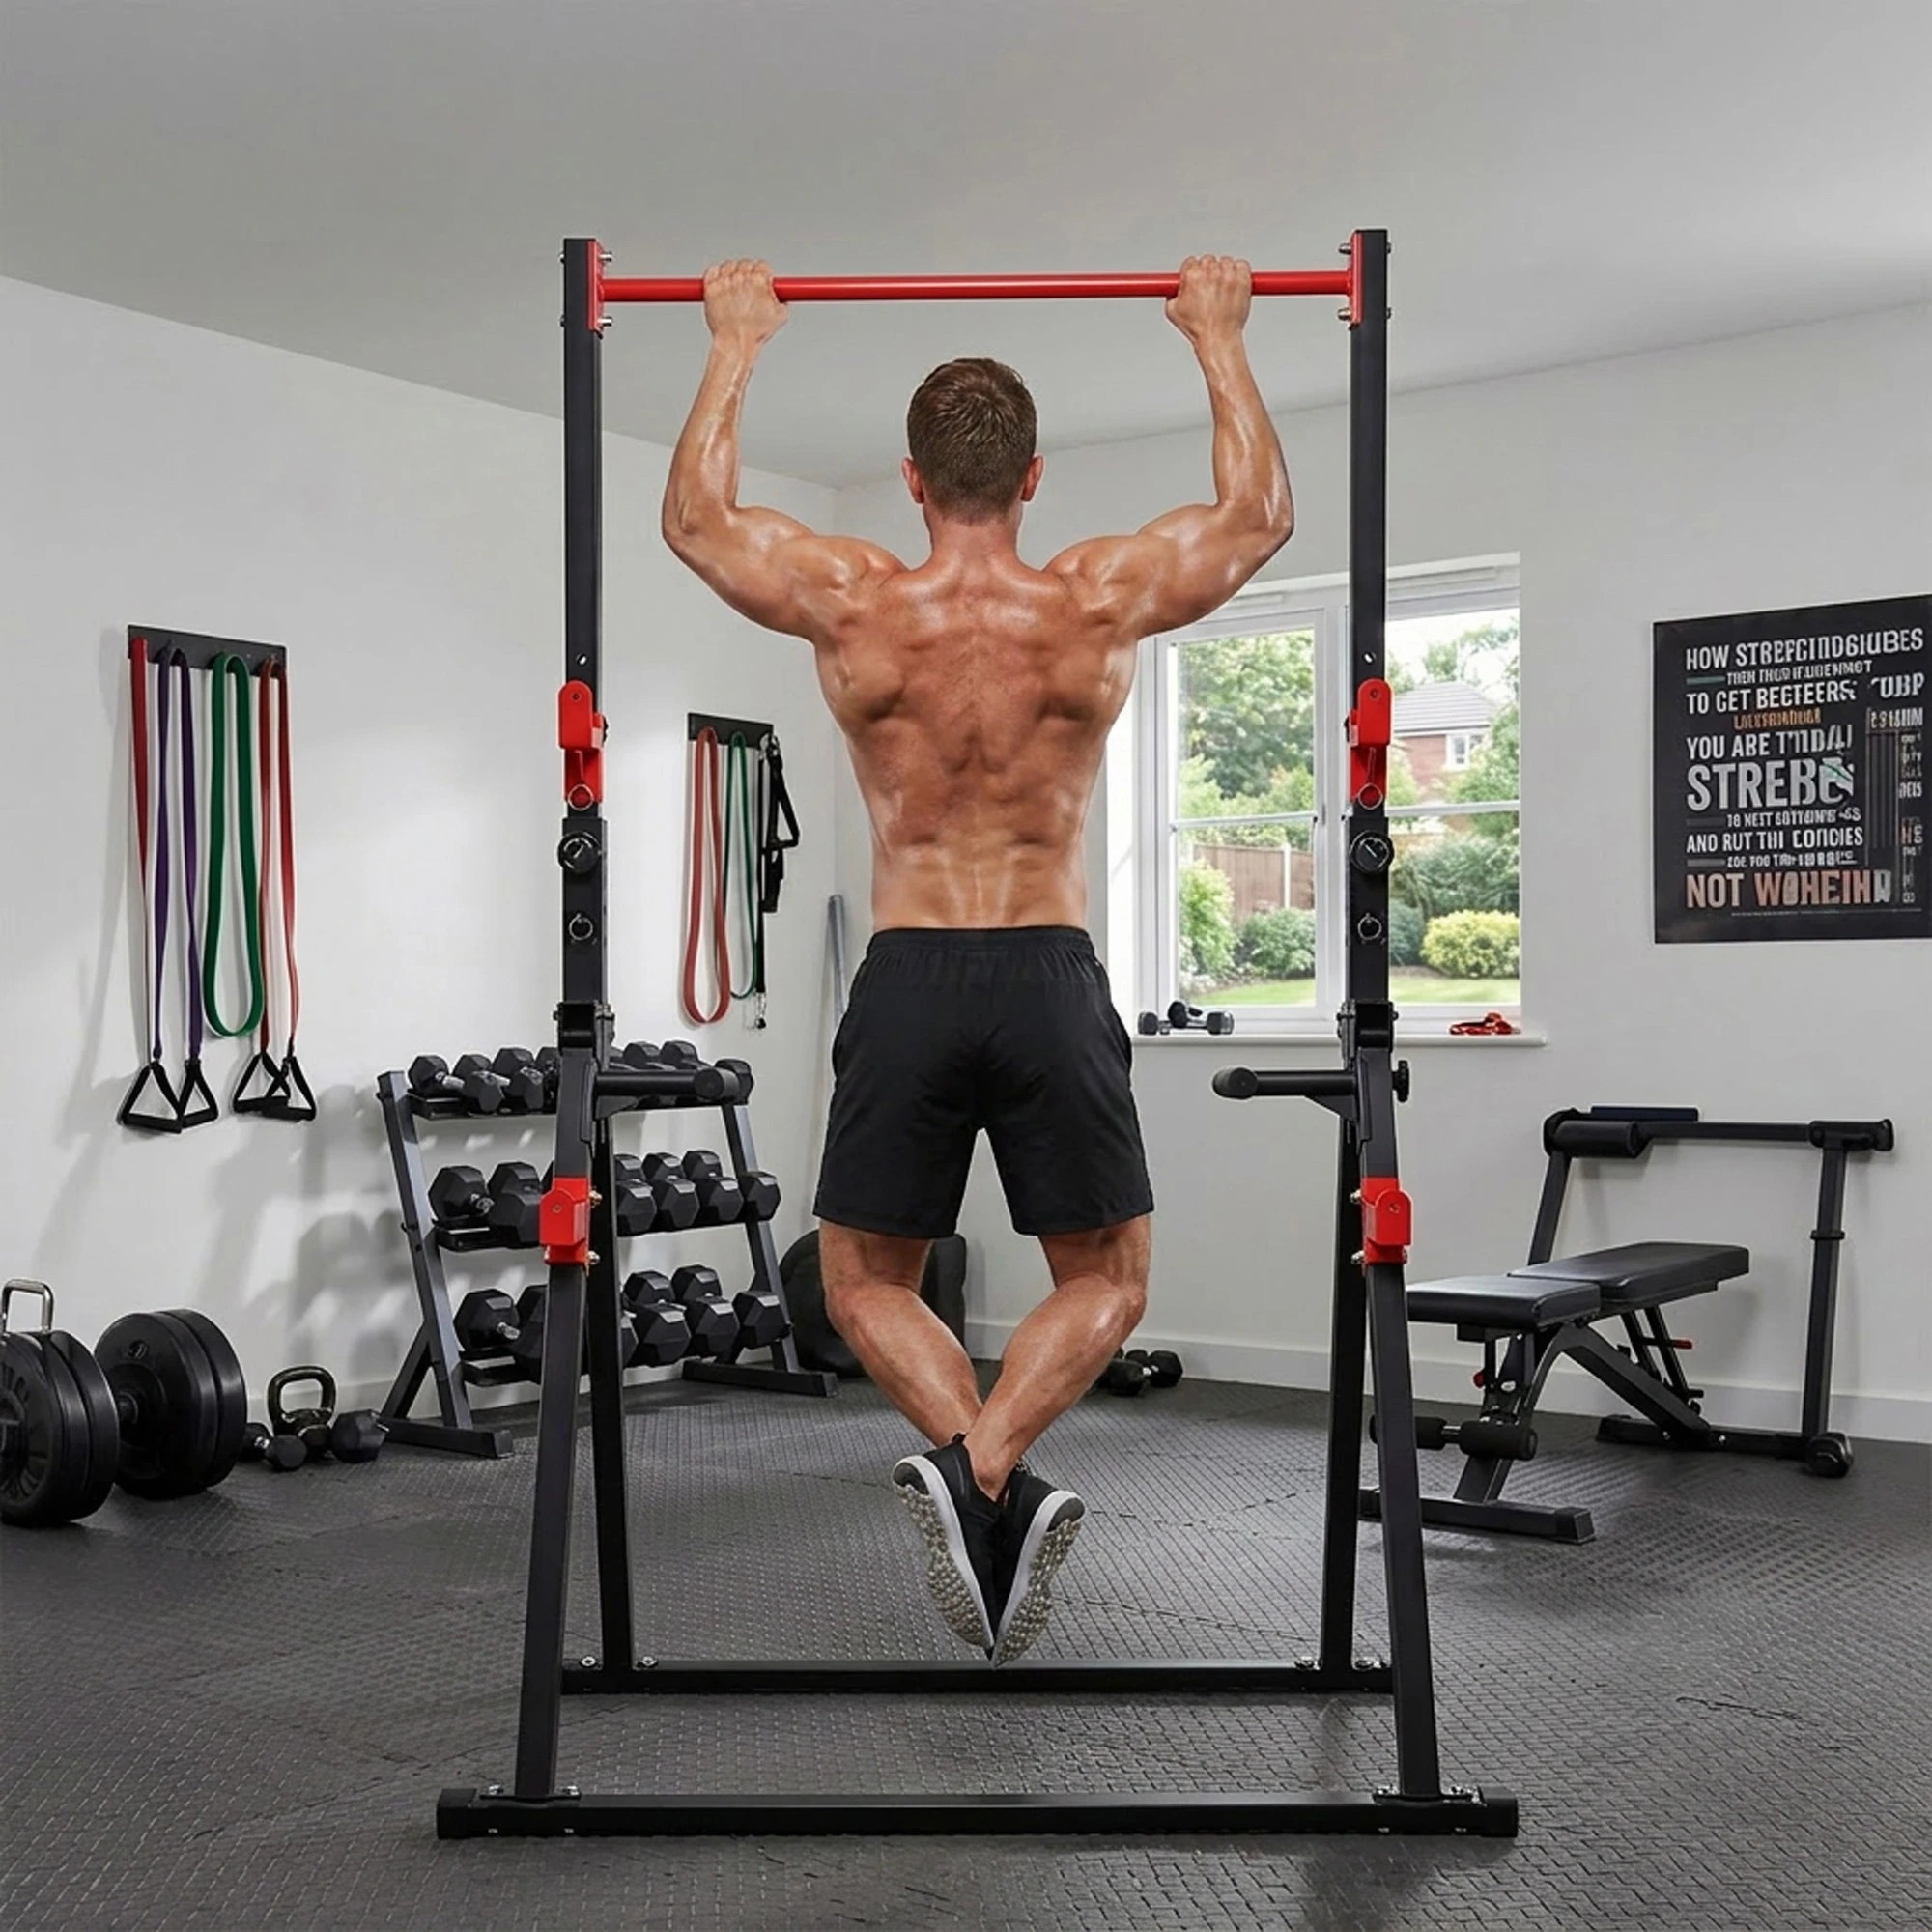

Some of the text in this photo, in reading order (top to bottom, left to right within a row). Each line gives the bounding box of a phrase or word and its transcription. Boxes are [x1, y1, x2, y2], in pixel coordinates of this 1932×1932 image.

[1686, 644, 1729, 670] HOW
[1687, 692, 1709, 714] TO
[1687, 735, 1725, 760] YOU
[1687, 835, 1718, 853] AND
[1686, 872, 1744, 908] NOT
